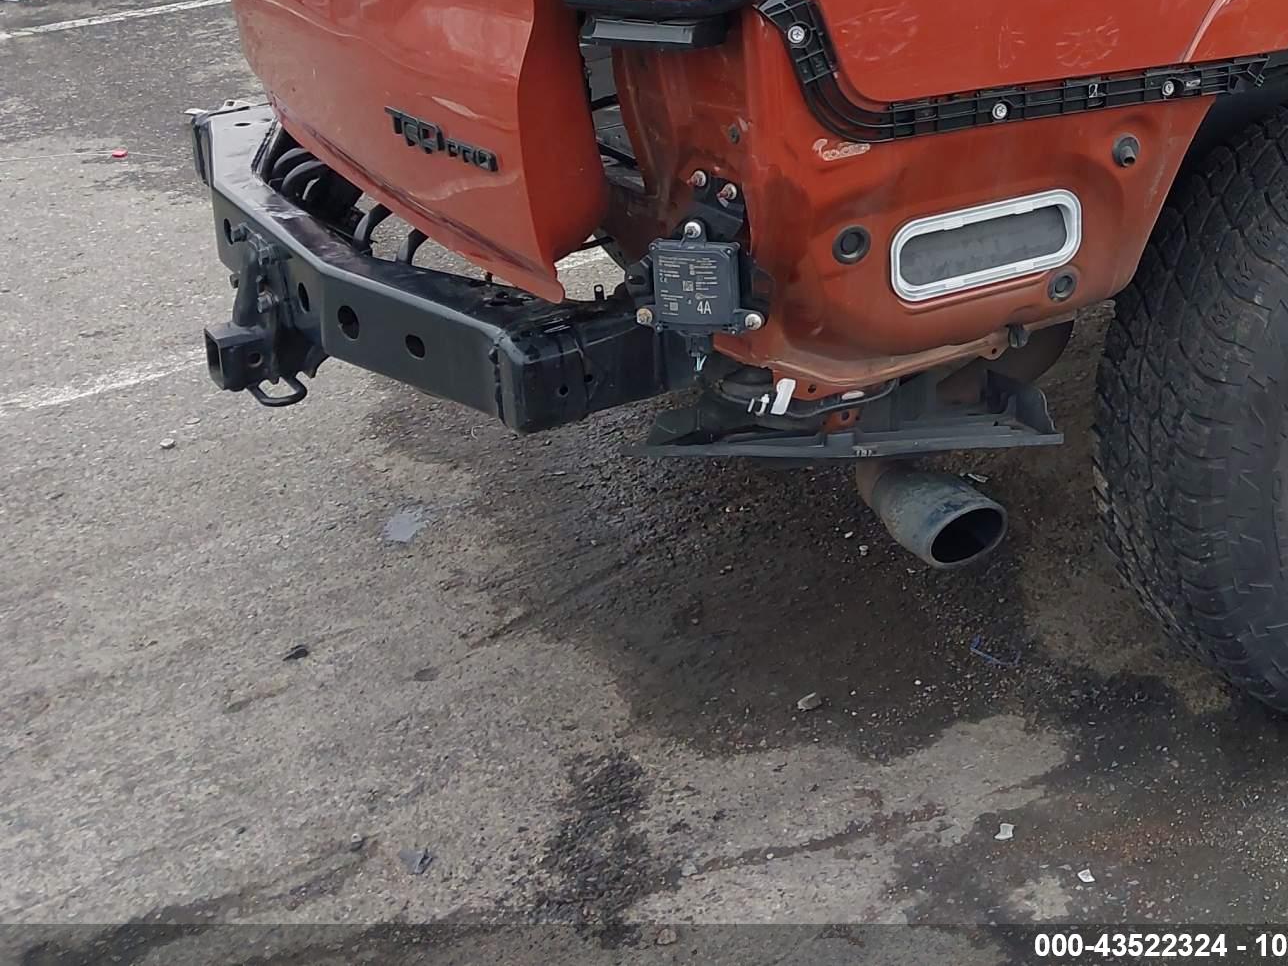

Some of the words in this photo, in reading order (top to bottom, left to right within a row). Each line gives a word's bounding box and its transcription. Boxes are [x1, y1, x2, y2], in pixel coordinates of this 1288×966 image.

[384, 105, 445, 154] TRD
[446, 137, 499, 172] PRO
[696, 300, 712, 315] 4A
